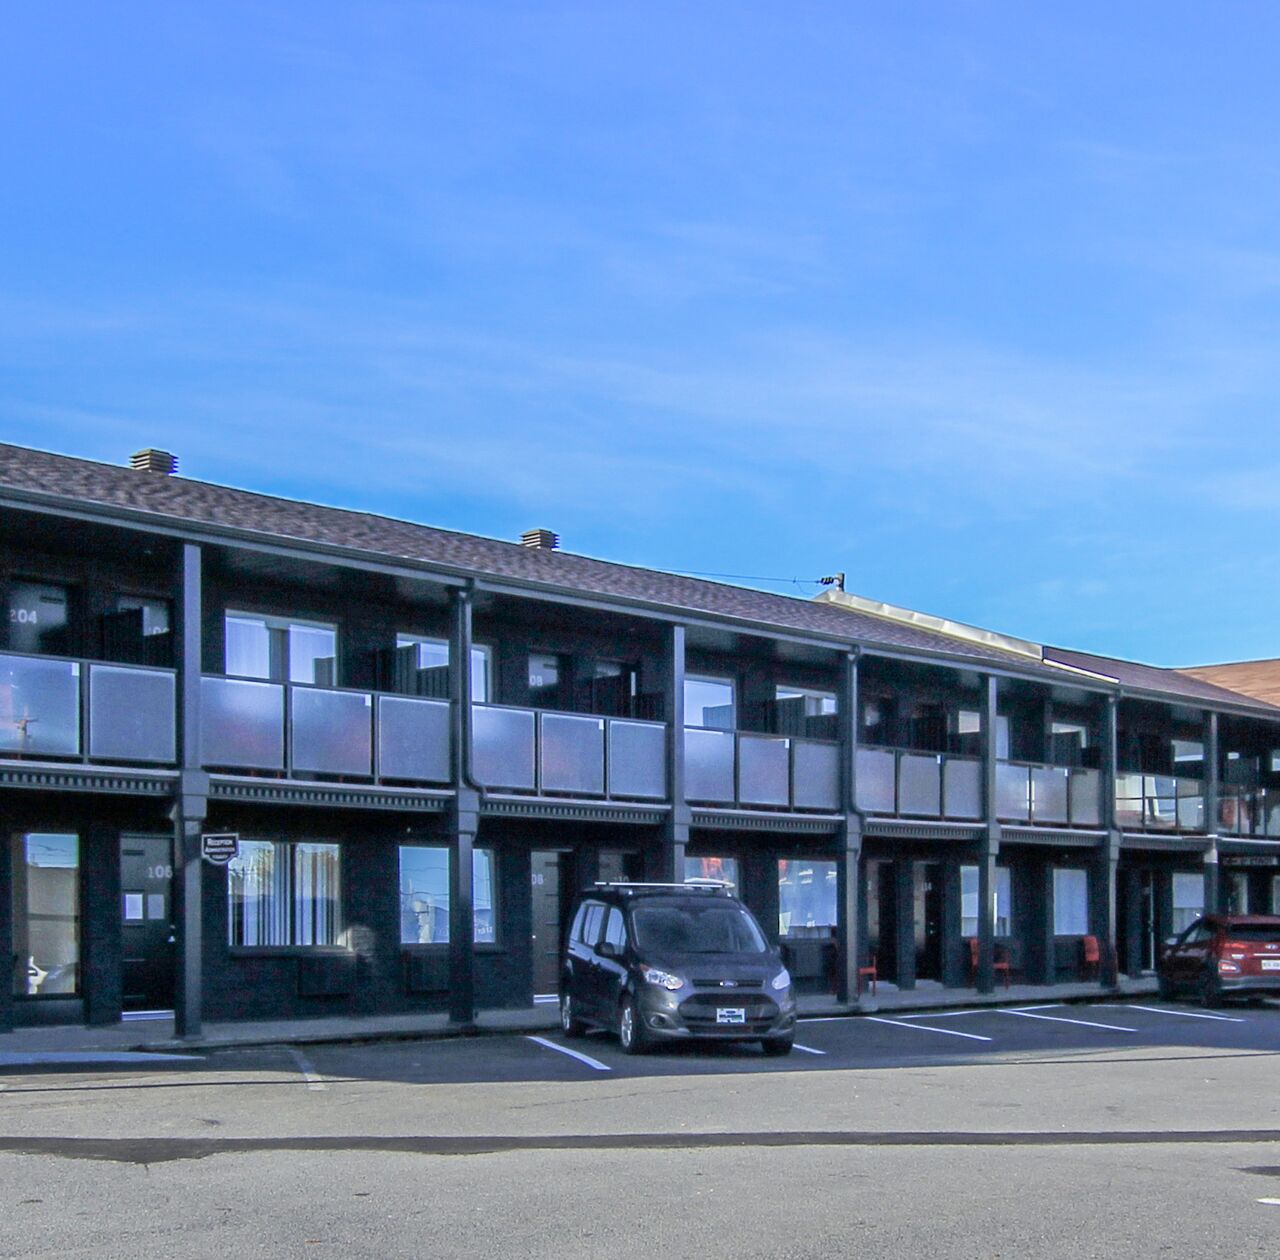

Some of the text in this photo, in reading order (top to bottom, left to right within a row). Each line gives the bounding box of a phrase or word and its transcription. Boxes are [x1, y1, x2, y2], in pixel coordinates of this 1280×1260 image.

[10, 608, 37, 624] 204
[529, 675, 543, 687] 08
[531, 873, 544, 885] 08
